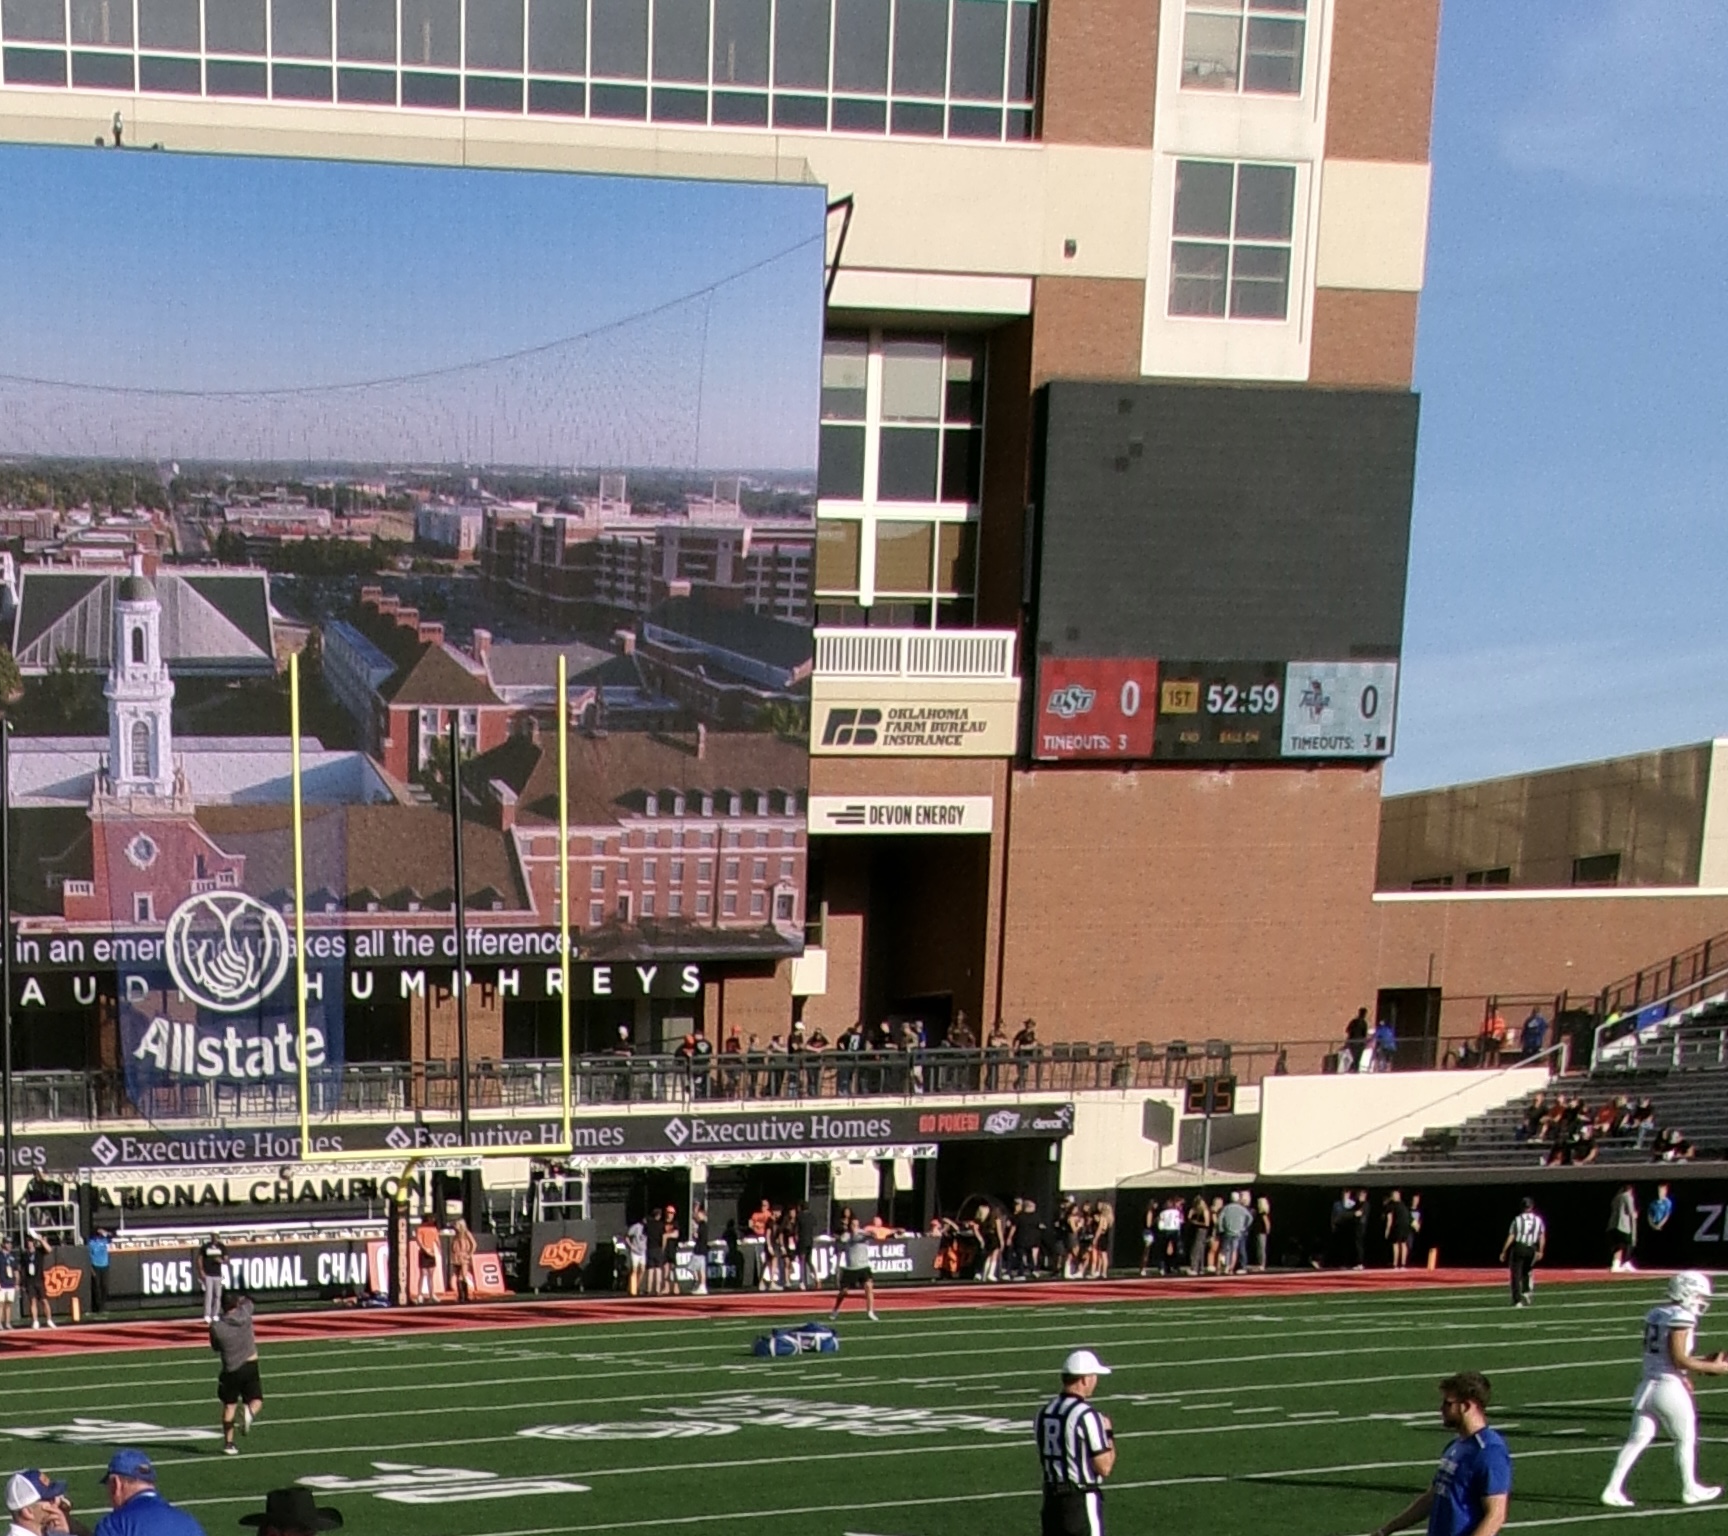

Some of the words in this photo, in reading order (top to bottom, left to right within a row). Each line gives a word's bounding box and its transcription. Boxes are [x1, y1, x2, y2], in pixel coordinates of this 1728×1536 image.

[1120, 679, 1141, 717] 0
[1168, 690, 1192, 708] 1ST
[1205, 684, 1280, 715] 52:59
[1360, 684, 1379, 720] 0
[884, 721, 927, 734] FARM
[929, 720, 988, 734] BUREAU
[887, 707, 970, 721] OKLAHOMA
[882, 734, 964, 747] INSURANCE
[1042, 734, 1111, 751] TIMEOUTS:
[1290, 735, 1355, 751] TIMEOUTS:
[1362, 734, 1372, 749] 3
[869, 804, 913, 826] DEVON
[915, 804, 966, 826] ENERGY
[15, 933, 41, 964] in
[49, 938, 85, 964] an
[354, 929, 385, 958] all
[392, 928, 435, 957] the
[441, 926, 580, 959] dfference,
[133, 1016, 326, 1079] Allstate
[413, 1124, 533, 1147] Exeutive
[690, 1115, 805, 1145] Executive
[810, 1114, 893, 1140] Homes
[120, 1132, 246, 1163] Executive
[96, 1177, 241, 1209] ATIONAL
[539, 1237, 588, 1271] OSU
[141, 1259, 194, 1296] 1945
[218, 1254, 309, 1292] ATIONAL
[1042, 1417, 1062, 1456] R
